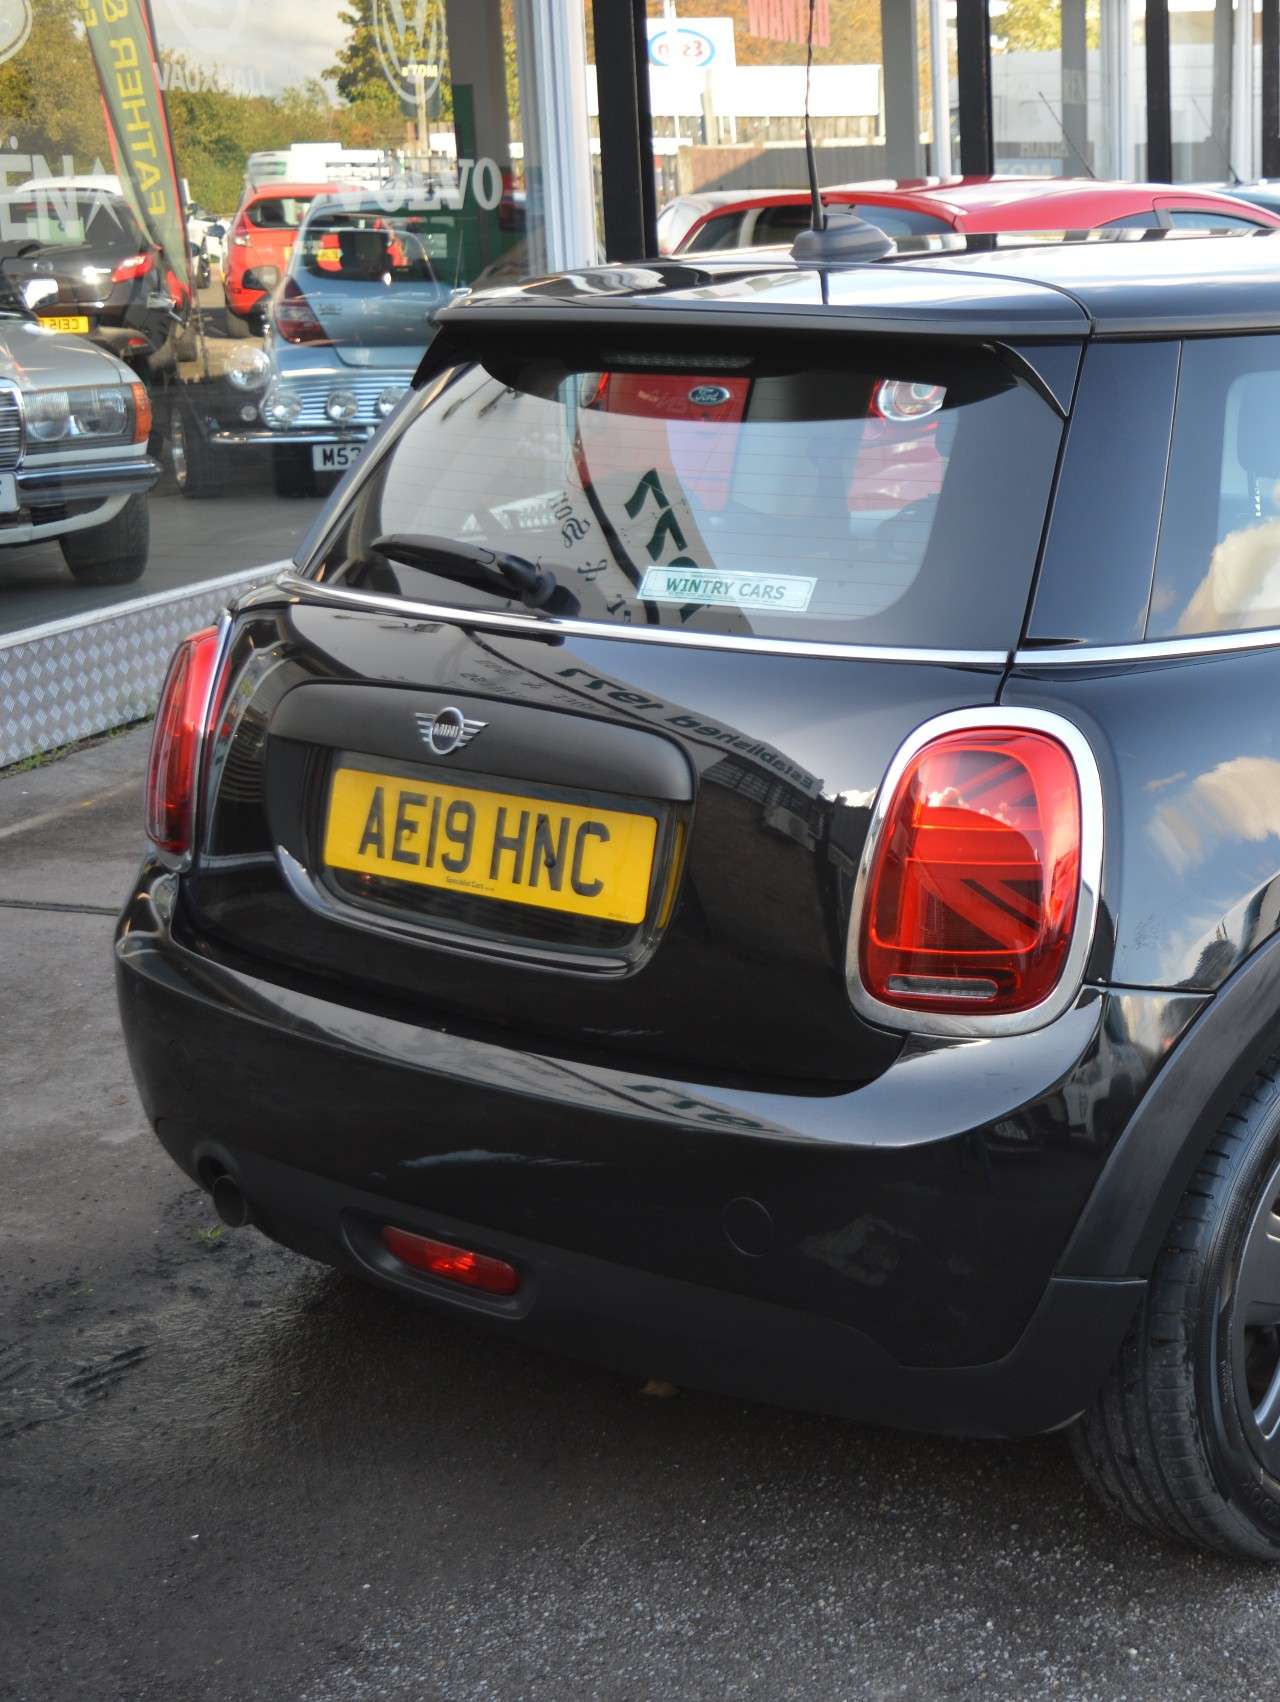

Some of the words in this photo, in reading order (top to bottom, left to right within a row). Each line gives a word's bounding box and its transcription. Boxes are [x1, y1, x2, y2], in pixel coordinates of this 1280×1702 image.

[665, 577, 734, 595] WINTRY
[738, 583, 787, 600] CARS
[433, 722, 459, 738] MINI
[358, 786, 476, 874] AE19
[489, 806, 611, 898] HNC
